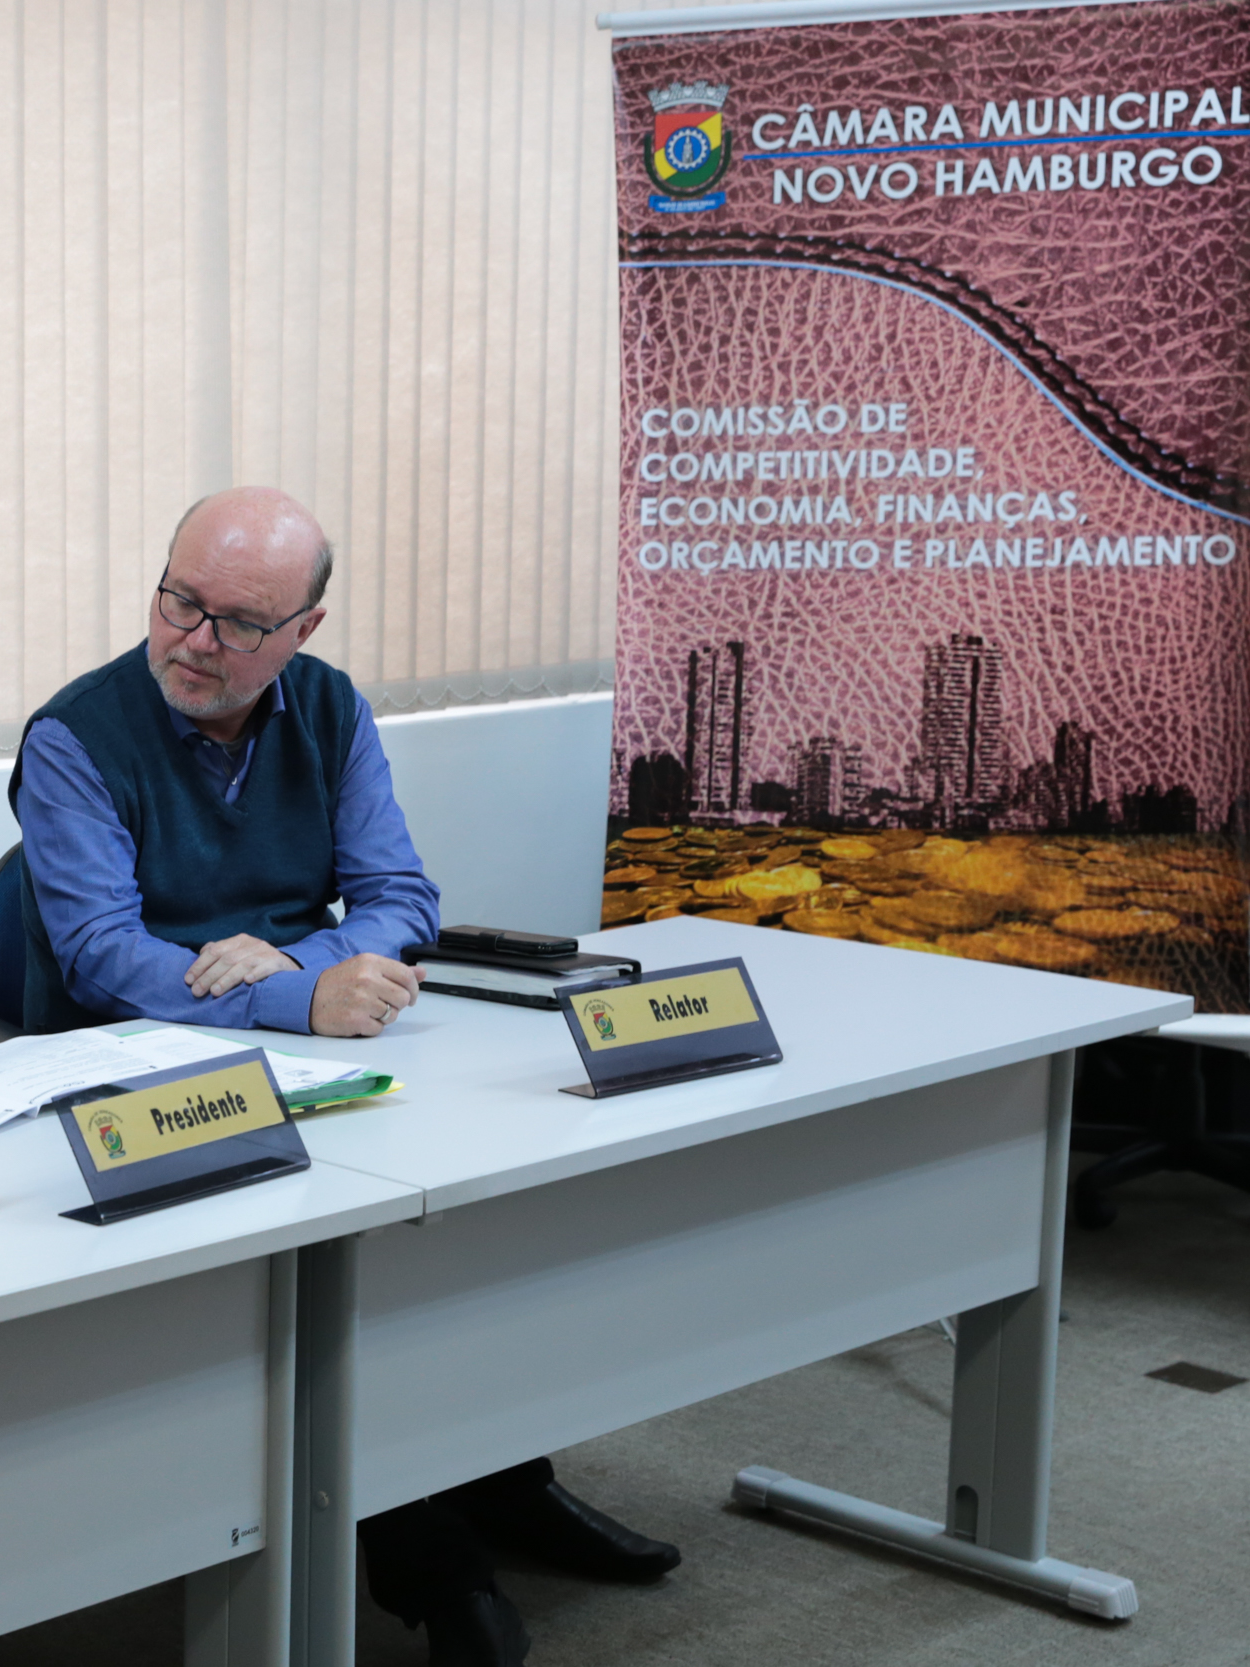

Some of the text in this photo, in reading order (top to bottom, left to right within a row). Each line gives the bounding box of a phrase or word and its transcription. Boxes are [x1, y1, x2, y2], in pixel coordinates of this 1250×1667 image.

[752, 86, 1250, 151] CÂMARA MUNICIPAL
[773, 146, 1223, 204] NOVO HAMBURGO
[641, 399, 908, 438] COMISSÃO DE
[640, 448, 985, 482] COMPETITIVIDADE,
[640, 490, 1088, 529] ECONOMIA, FINANÇAS,
[639, 534, 1237, 576] ORÇAMENTO E PLANEJAMENTO
[648, 994, 710, 1022] Relator
[150, 1090, 248, 1137] Presidente
